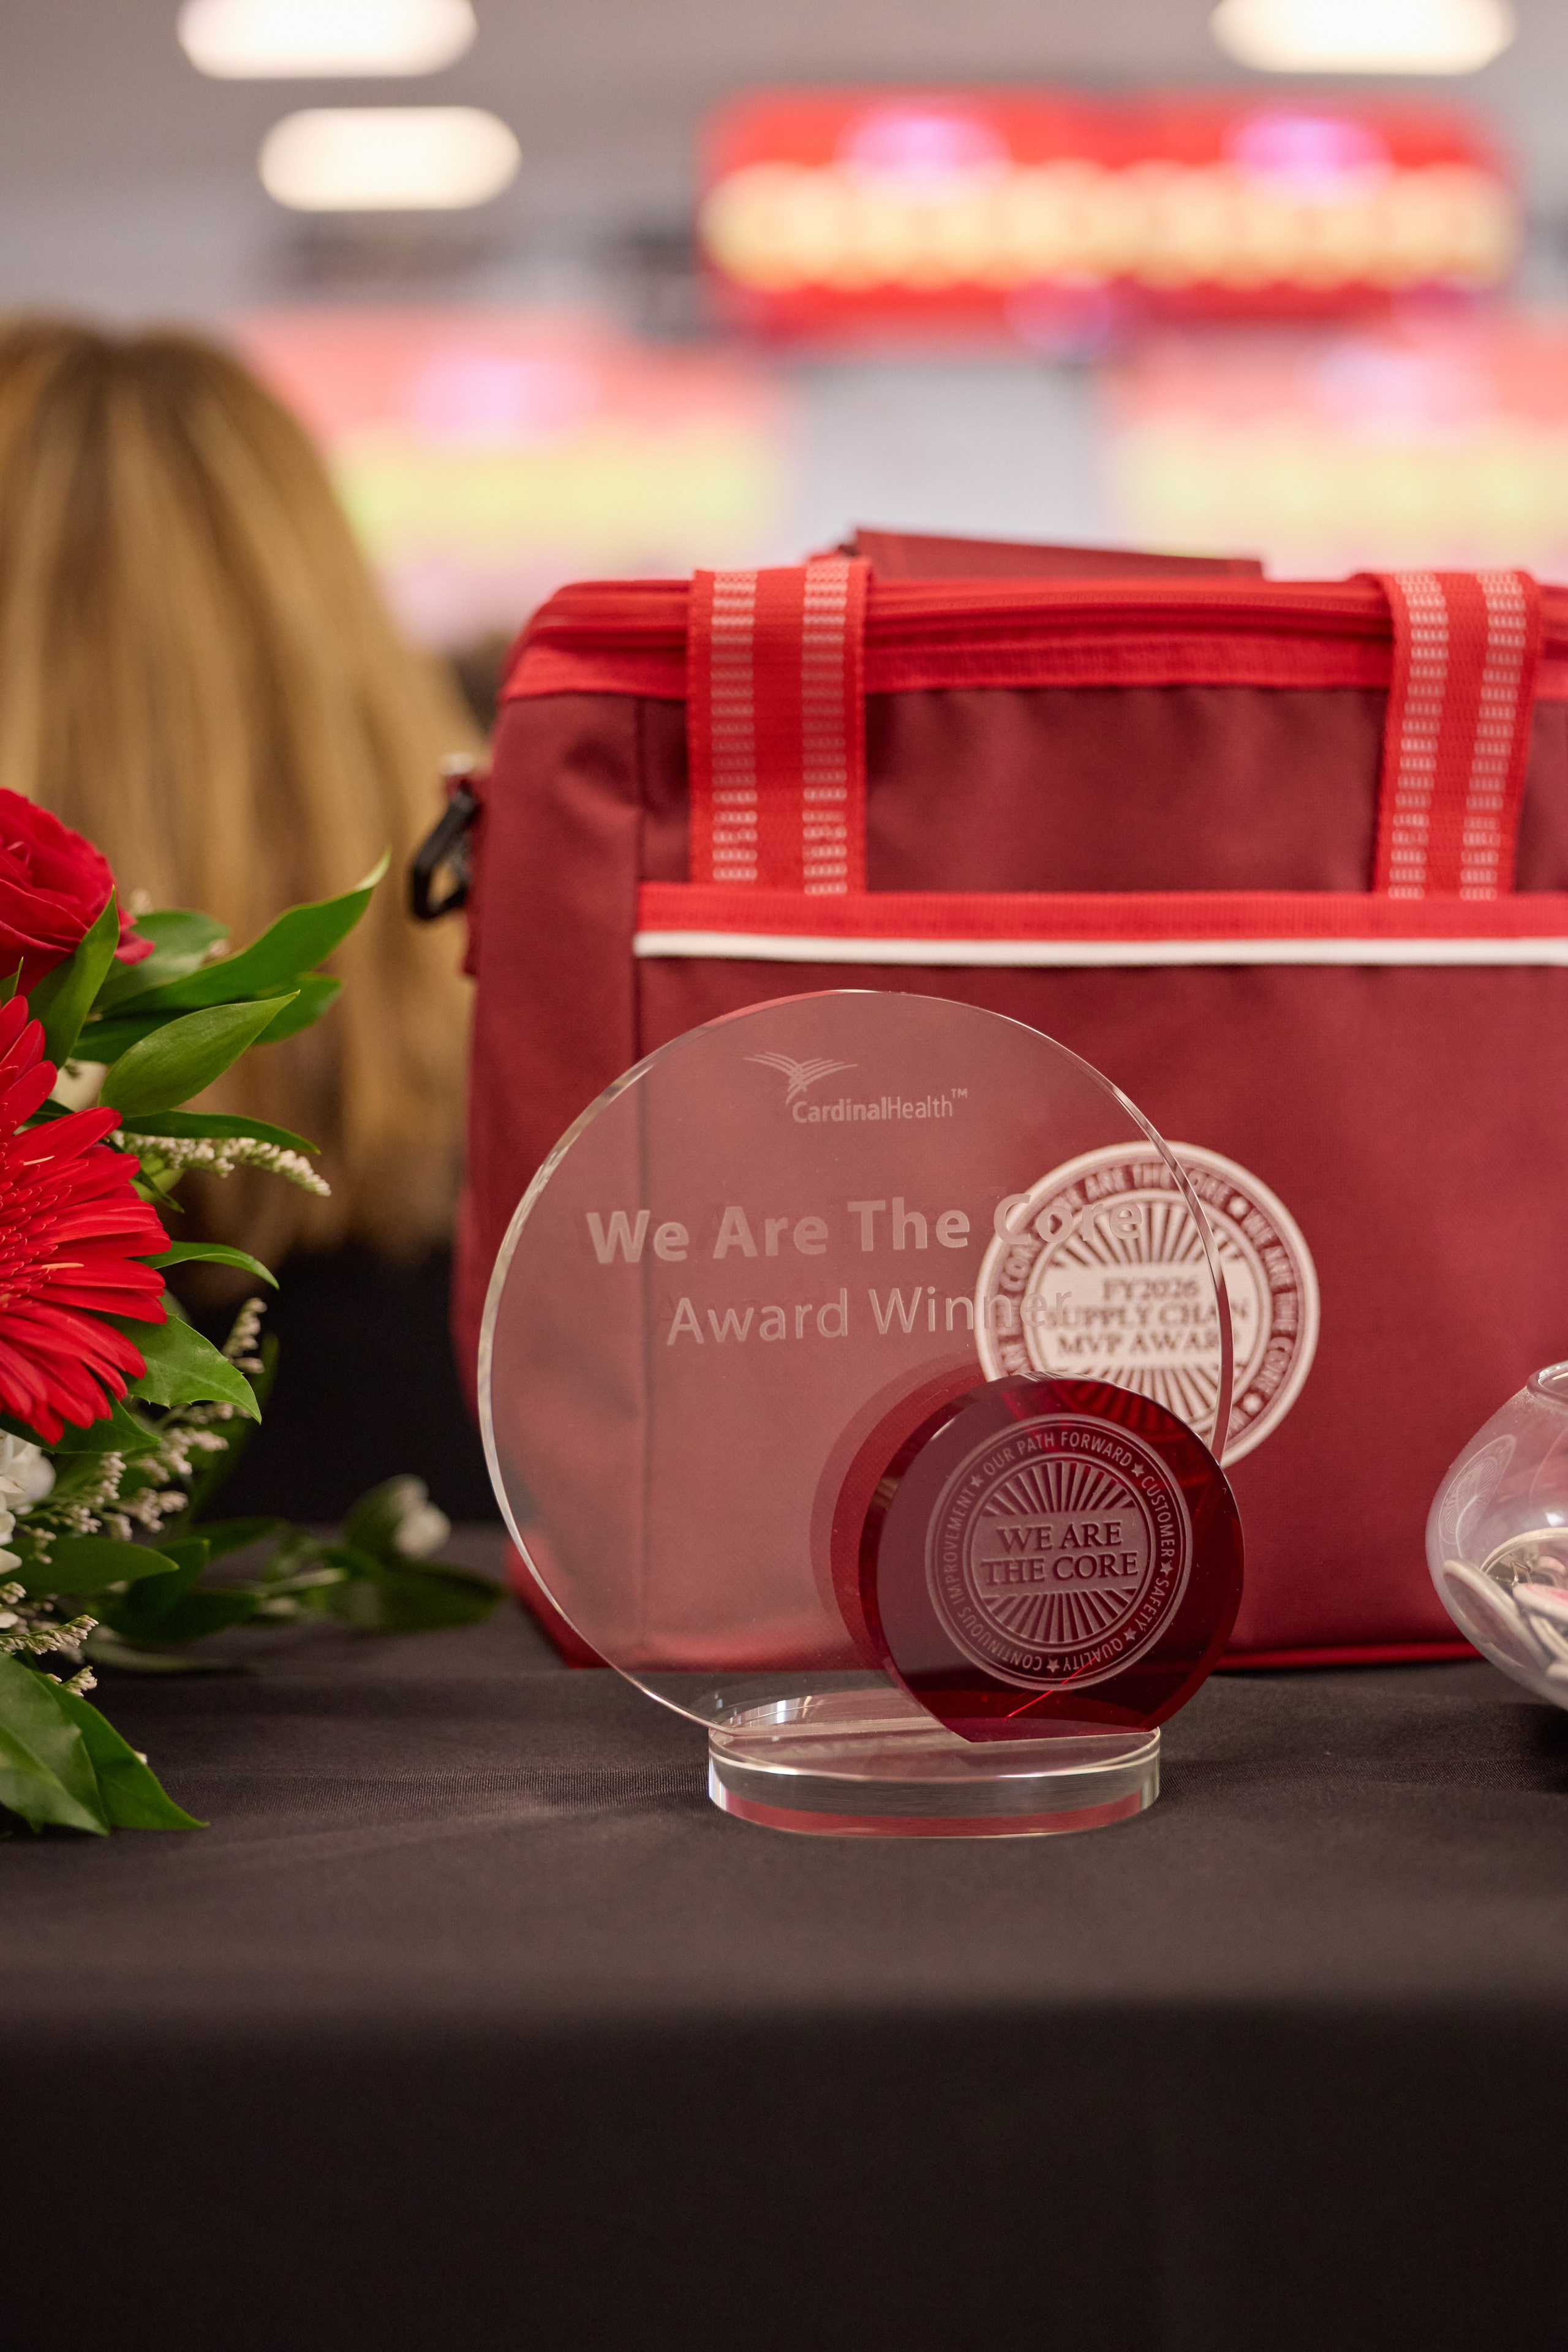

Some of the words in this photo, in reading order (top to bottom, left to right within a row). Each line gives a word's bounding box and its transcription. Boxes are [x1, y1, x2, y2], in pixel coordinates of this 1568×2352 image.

[586, 1210, 690, 1264] We
[712, 1205, 829, 1259] Are
[848, 1197, 970, 1252] The
[993, 1193, 1143, 1245] Core
[667, 1288, 848, 1346] Award
[869, 1286, 1072, 1335] Winner
[1158, 1298, 1250, 1325] CHAN
[1016, 1432, 1055, 1454] PATH
[1061, 1431, 1133, 1466] FORWARD
[982, 1447, 1014, 1476] OUR
[1141, 1476, 1176, 1558] CUSTOMER
[943, 1488, 976, 1605] IMPROVEMENT
[997, 1524, 1053, 1554] WE
[1058, 1521, 1123, 1550] ARE
[980, 1556, 1045, 1586] THE
[1052, 1551, 1139, 1581] CORE
[1134, 1577, 1170, 1632] SAFETY
[957, 1605, 1042, 1672] CONTINUOUS
[1062, 1637, 1124, 1672] QUALITY
